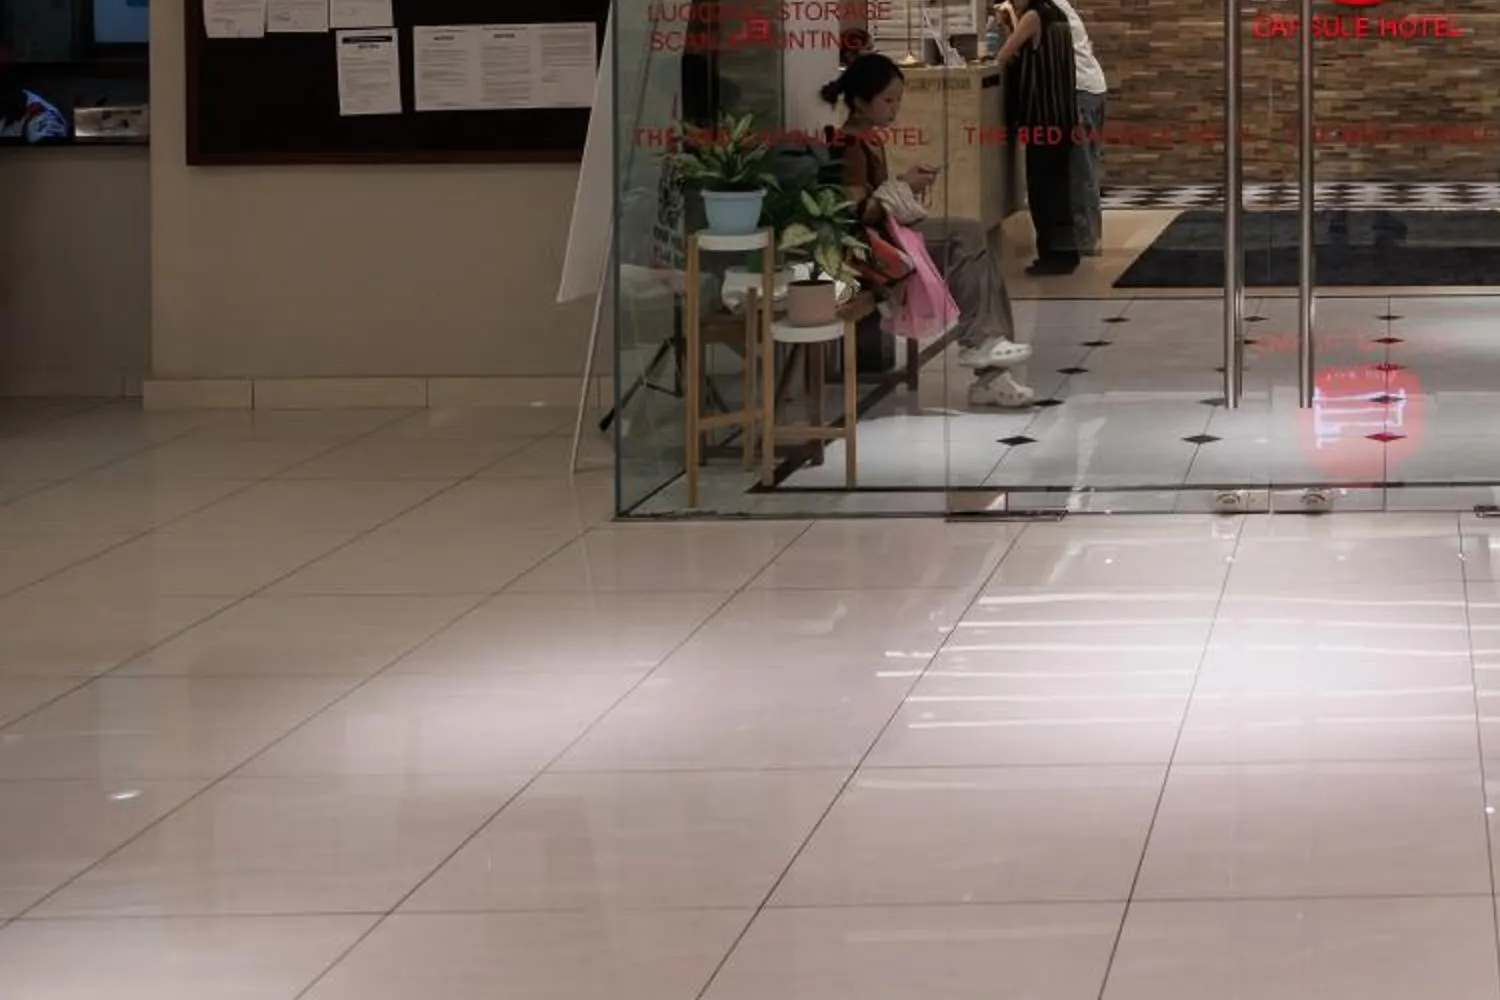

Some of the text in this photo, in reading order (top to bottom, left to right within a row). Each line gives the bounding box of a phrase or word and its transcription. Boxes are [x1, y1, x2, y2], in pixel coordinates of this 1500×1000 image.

[779, 2, 891, 21] STORAGE
[1378, 14, 1464, 37] HOTEL
[633, 127, 677, 147] THE
[964, 126, 1008, 145] THE
[1017, 126, 1063, 146] BED
